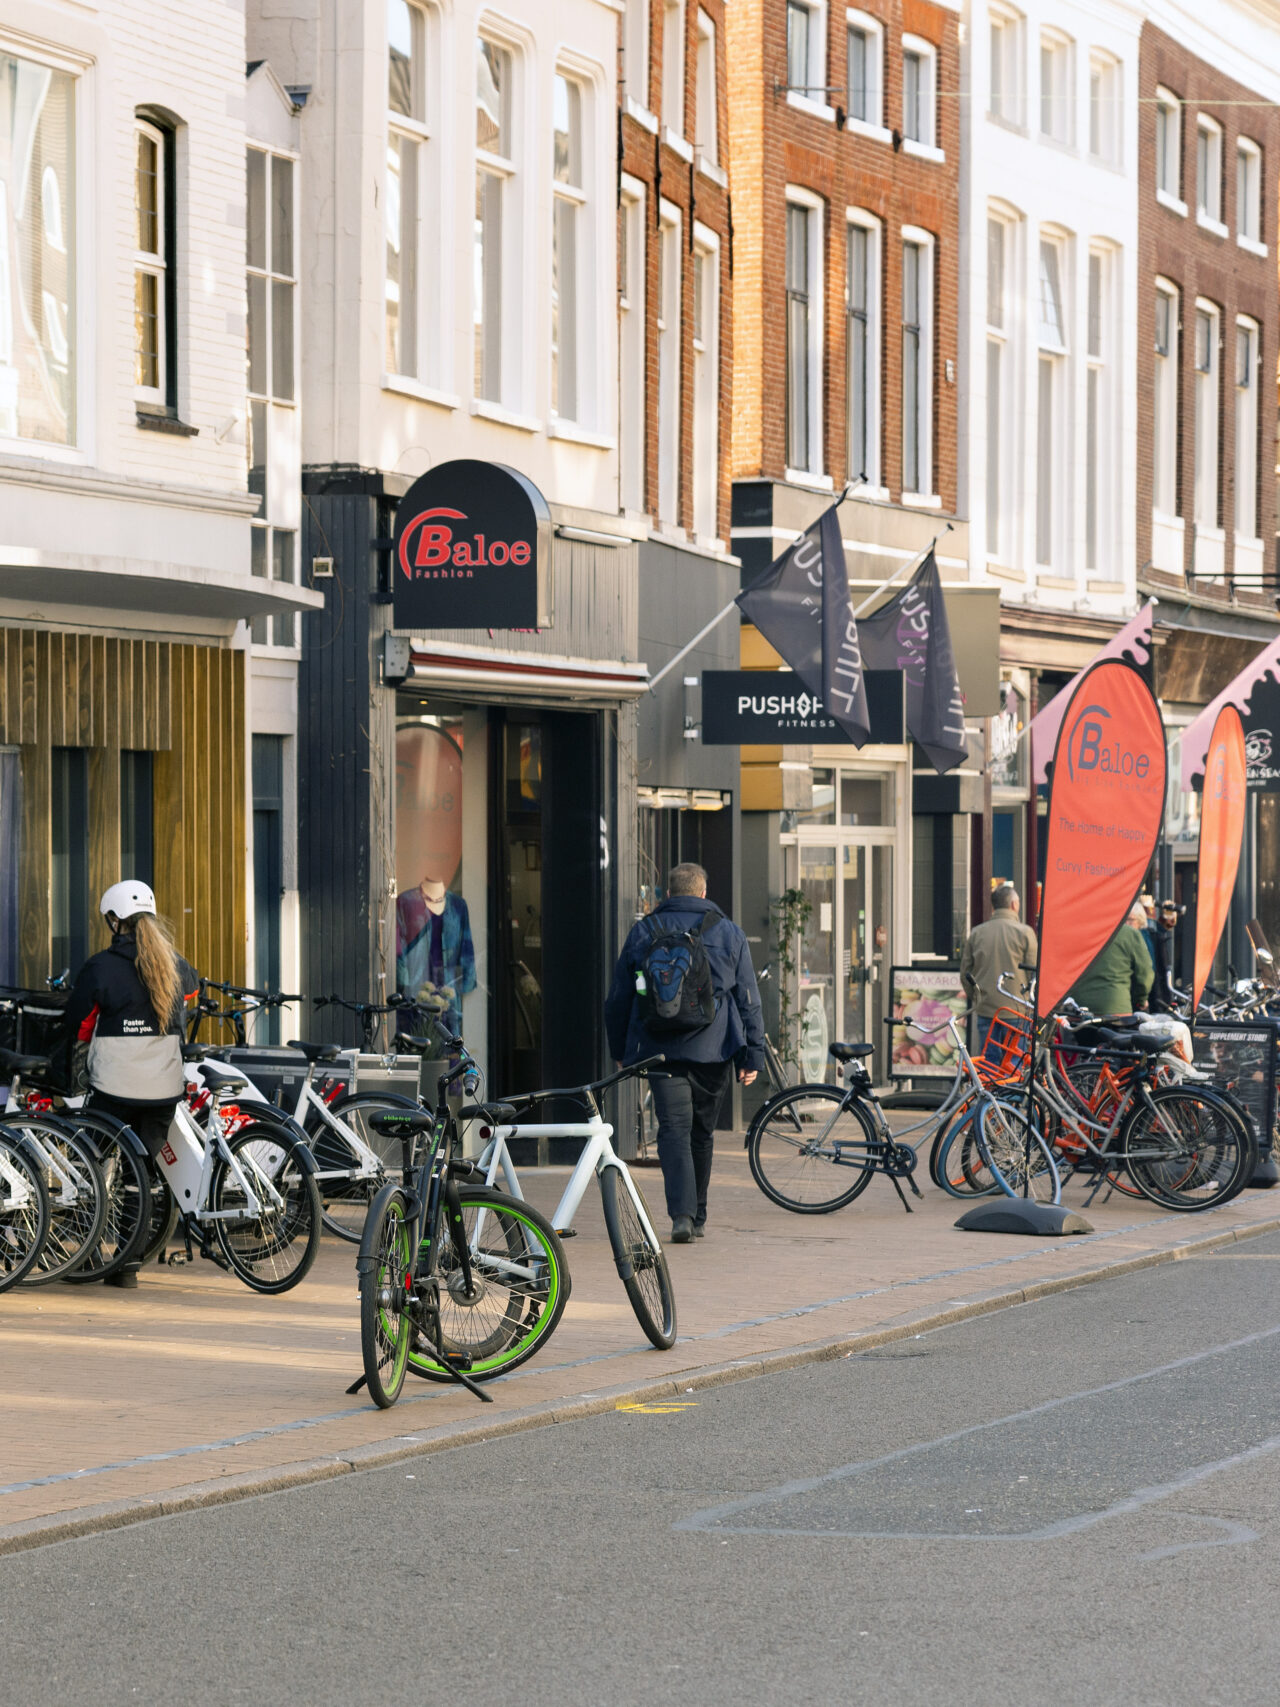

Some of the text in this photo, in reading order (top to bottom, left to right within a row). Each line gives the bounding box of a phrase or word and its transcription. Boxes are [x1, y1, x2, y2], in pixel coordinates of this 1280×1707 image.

[414, 524, 532, 567] Baloe
[415, 568, 474, 579] Fashion
[738, 696, 795, 715] PUSH
[778, 720, 836, 728] FITNESS
[1077, 721, 1150, 779] Baloe
[1059, 817, 1076, 832] The
[1077, 820, 1104, 836] Home
[1118, 825, 1146, 843] Happy
[1056, 858, 1082, 878] Curvy
